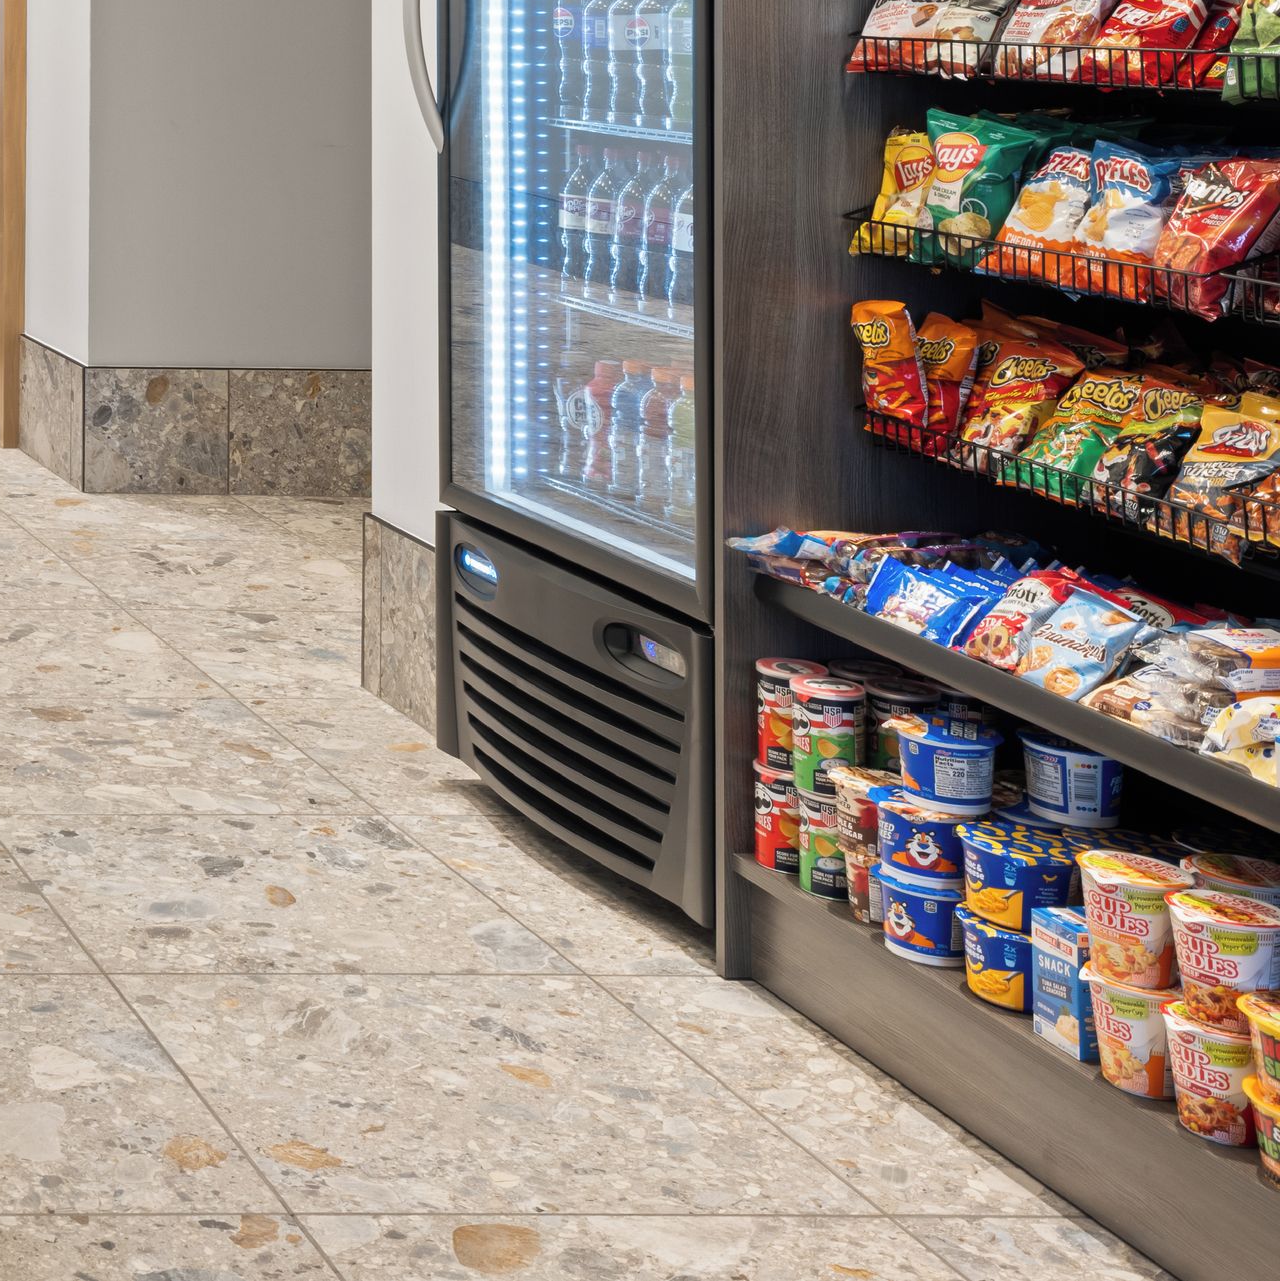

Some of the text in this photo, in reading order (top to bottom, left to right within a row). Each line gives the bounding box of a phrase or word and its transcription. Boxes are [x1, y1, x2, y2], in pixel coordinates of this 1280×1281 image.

[897, 157, 933, 187] Lay's
[918, 338, 952, 362] eetos
[991, 356, 1053, 387] Cheetos
[1125, 499, 1138, 510] 320
[1214, 524, 1228, 536] 310
[979, 619, 1003, 629] STRA
[776, 687, 792, 696] USA
[824, 707, 841, 716] USA
[892, 706, 910, 715] USA
[935, 756, 965, 764] Nutrition
[821, 805, 837, 815] USA
[842, 827, 863, 841] SUGAR
[1004, 862, 1017, 871] 2x
[1088, 889, 1132, 915] CUP
[1134, 902, 1164, 911] Paper Cup
[1004, 943, 1017, 953] 2x
[1177, 930, 1220, 956] CUP
[1221, 942, 1254, 951] Paper Cup
[1059, 943, 1072, 956] BEE
[1038, 954, 1071, 977] SNACK
[1045, 986, 1067, 999] CRACKERS
[1092, 1000, 1114, 1016] UP
[1170, 1040, 1211, 1067] CUP
